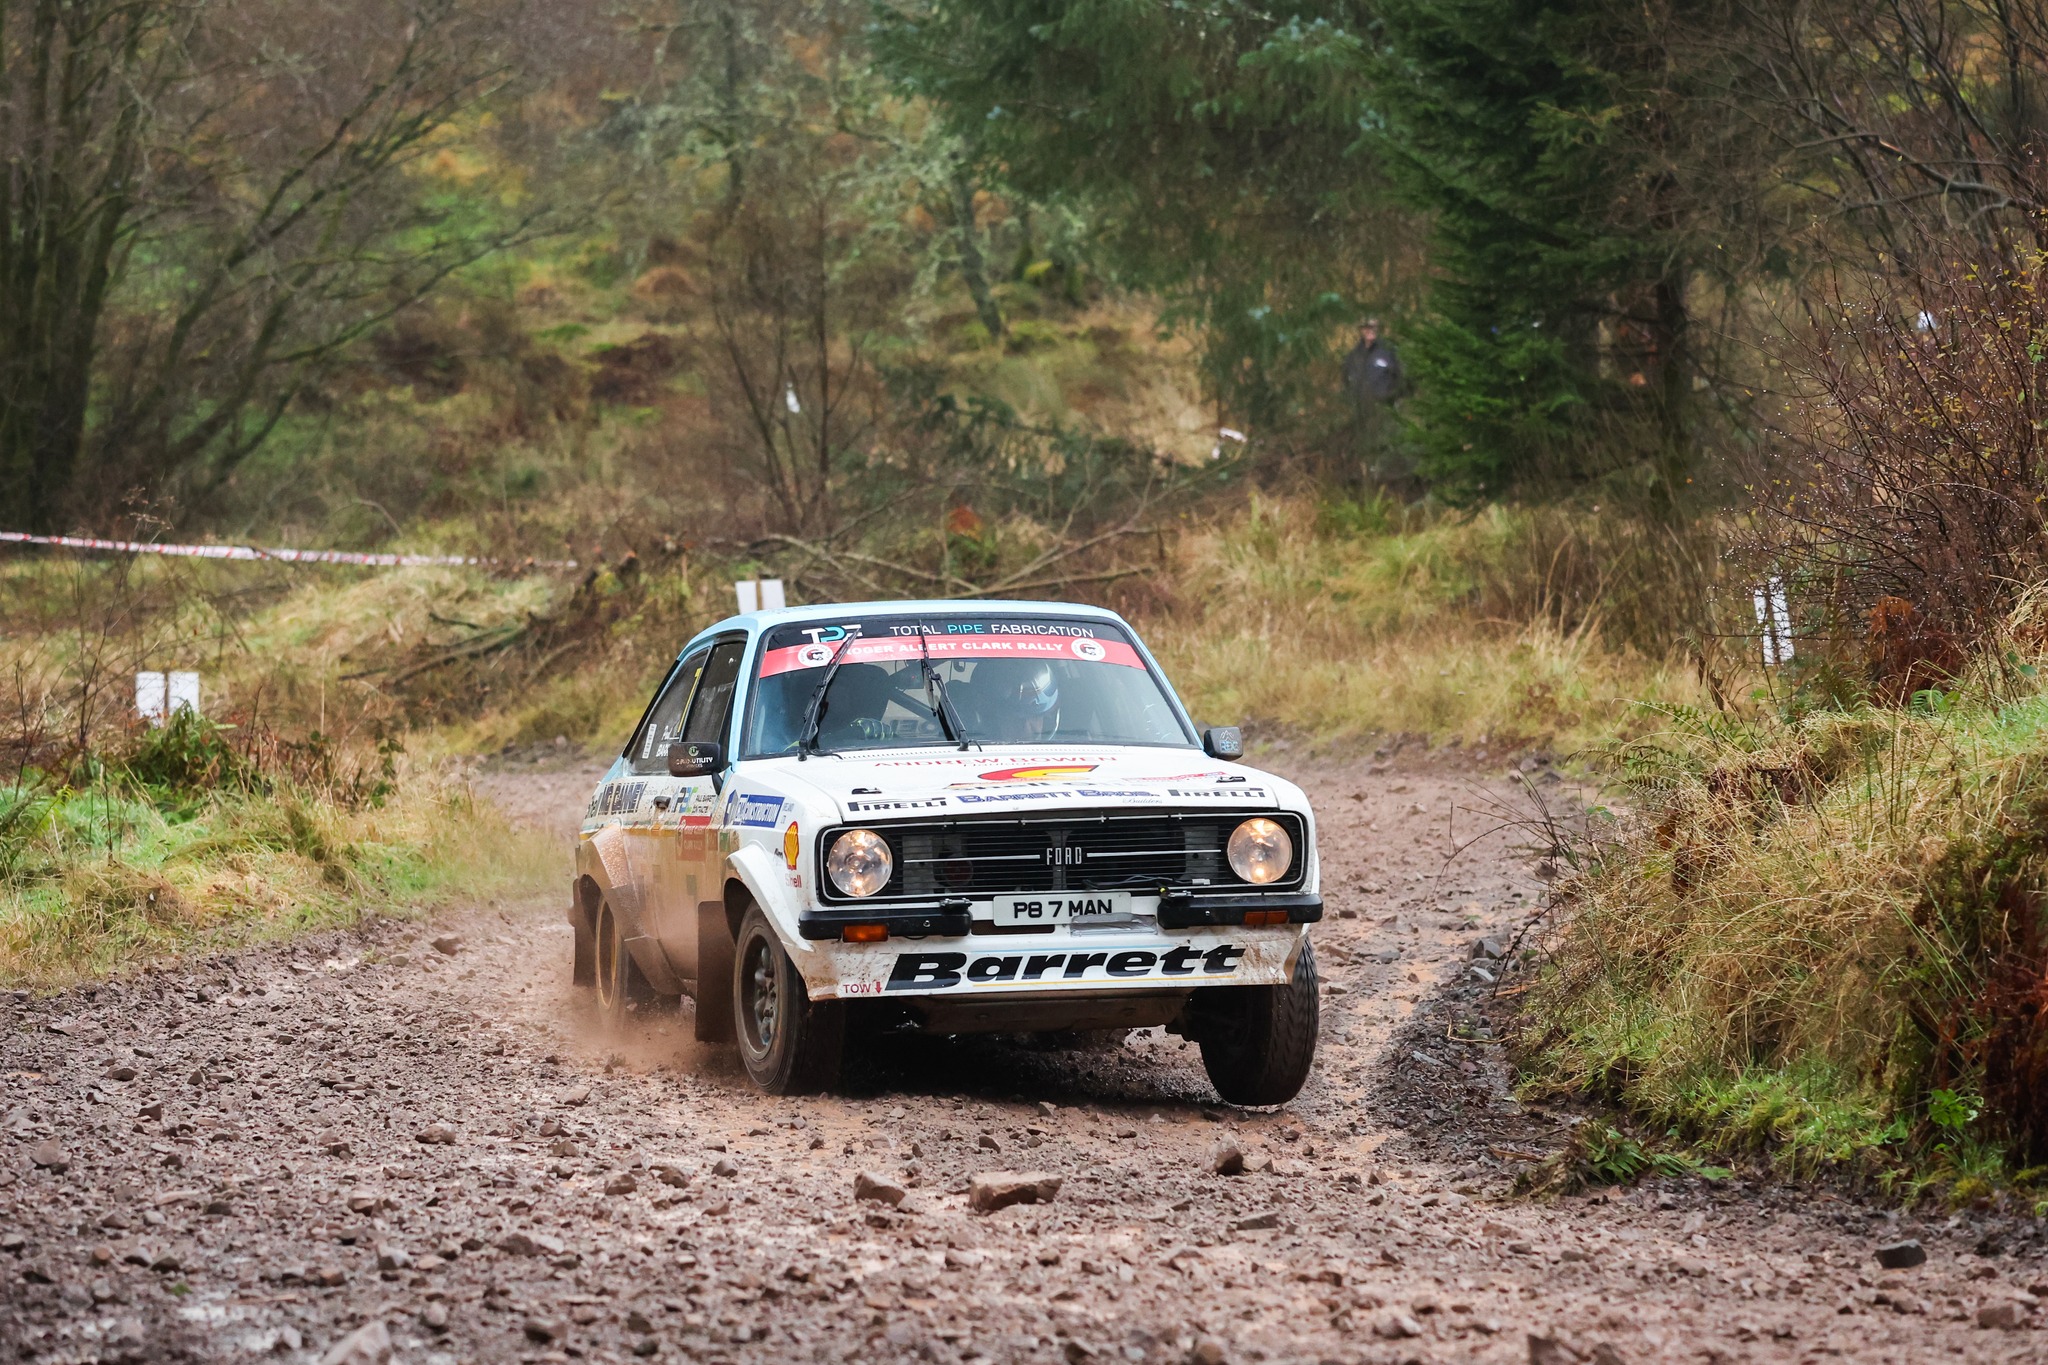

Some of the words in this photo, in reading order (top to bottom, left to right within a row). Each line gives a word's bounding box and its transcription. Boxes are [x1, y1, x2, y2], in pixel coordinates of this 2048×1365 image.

[890, 624, 941, 636] TOTAL
[947, 624, 985, 634] PIPE
[991, 624, 1094, 638] FABRICATION
[845, 645, 894, 655] OGER
[962, 642, 1013, 650] CLARK
[1017, 642, 1064, 651] RALLY
[874, 757, 999, 767] ANDREW
[1167, 787, 1266, 798] PIRELLI
[847, 797, 947, 811] PIRELLI
[1046, 847, 1082, 865] FORD
[1068, 899, 1113, 917] MAN
[885, 944, 1246, 991] Barrett
[843, 984, 872, 994] TOW
